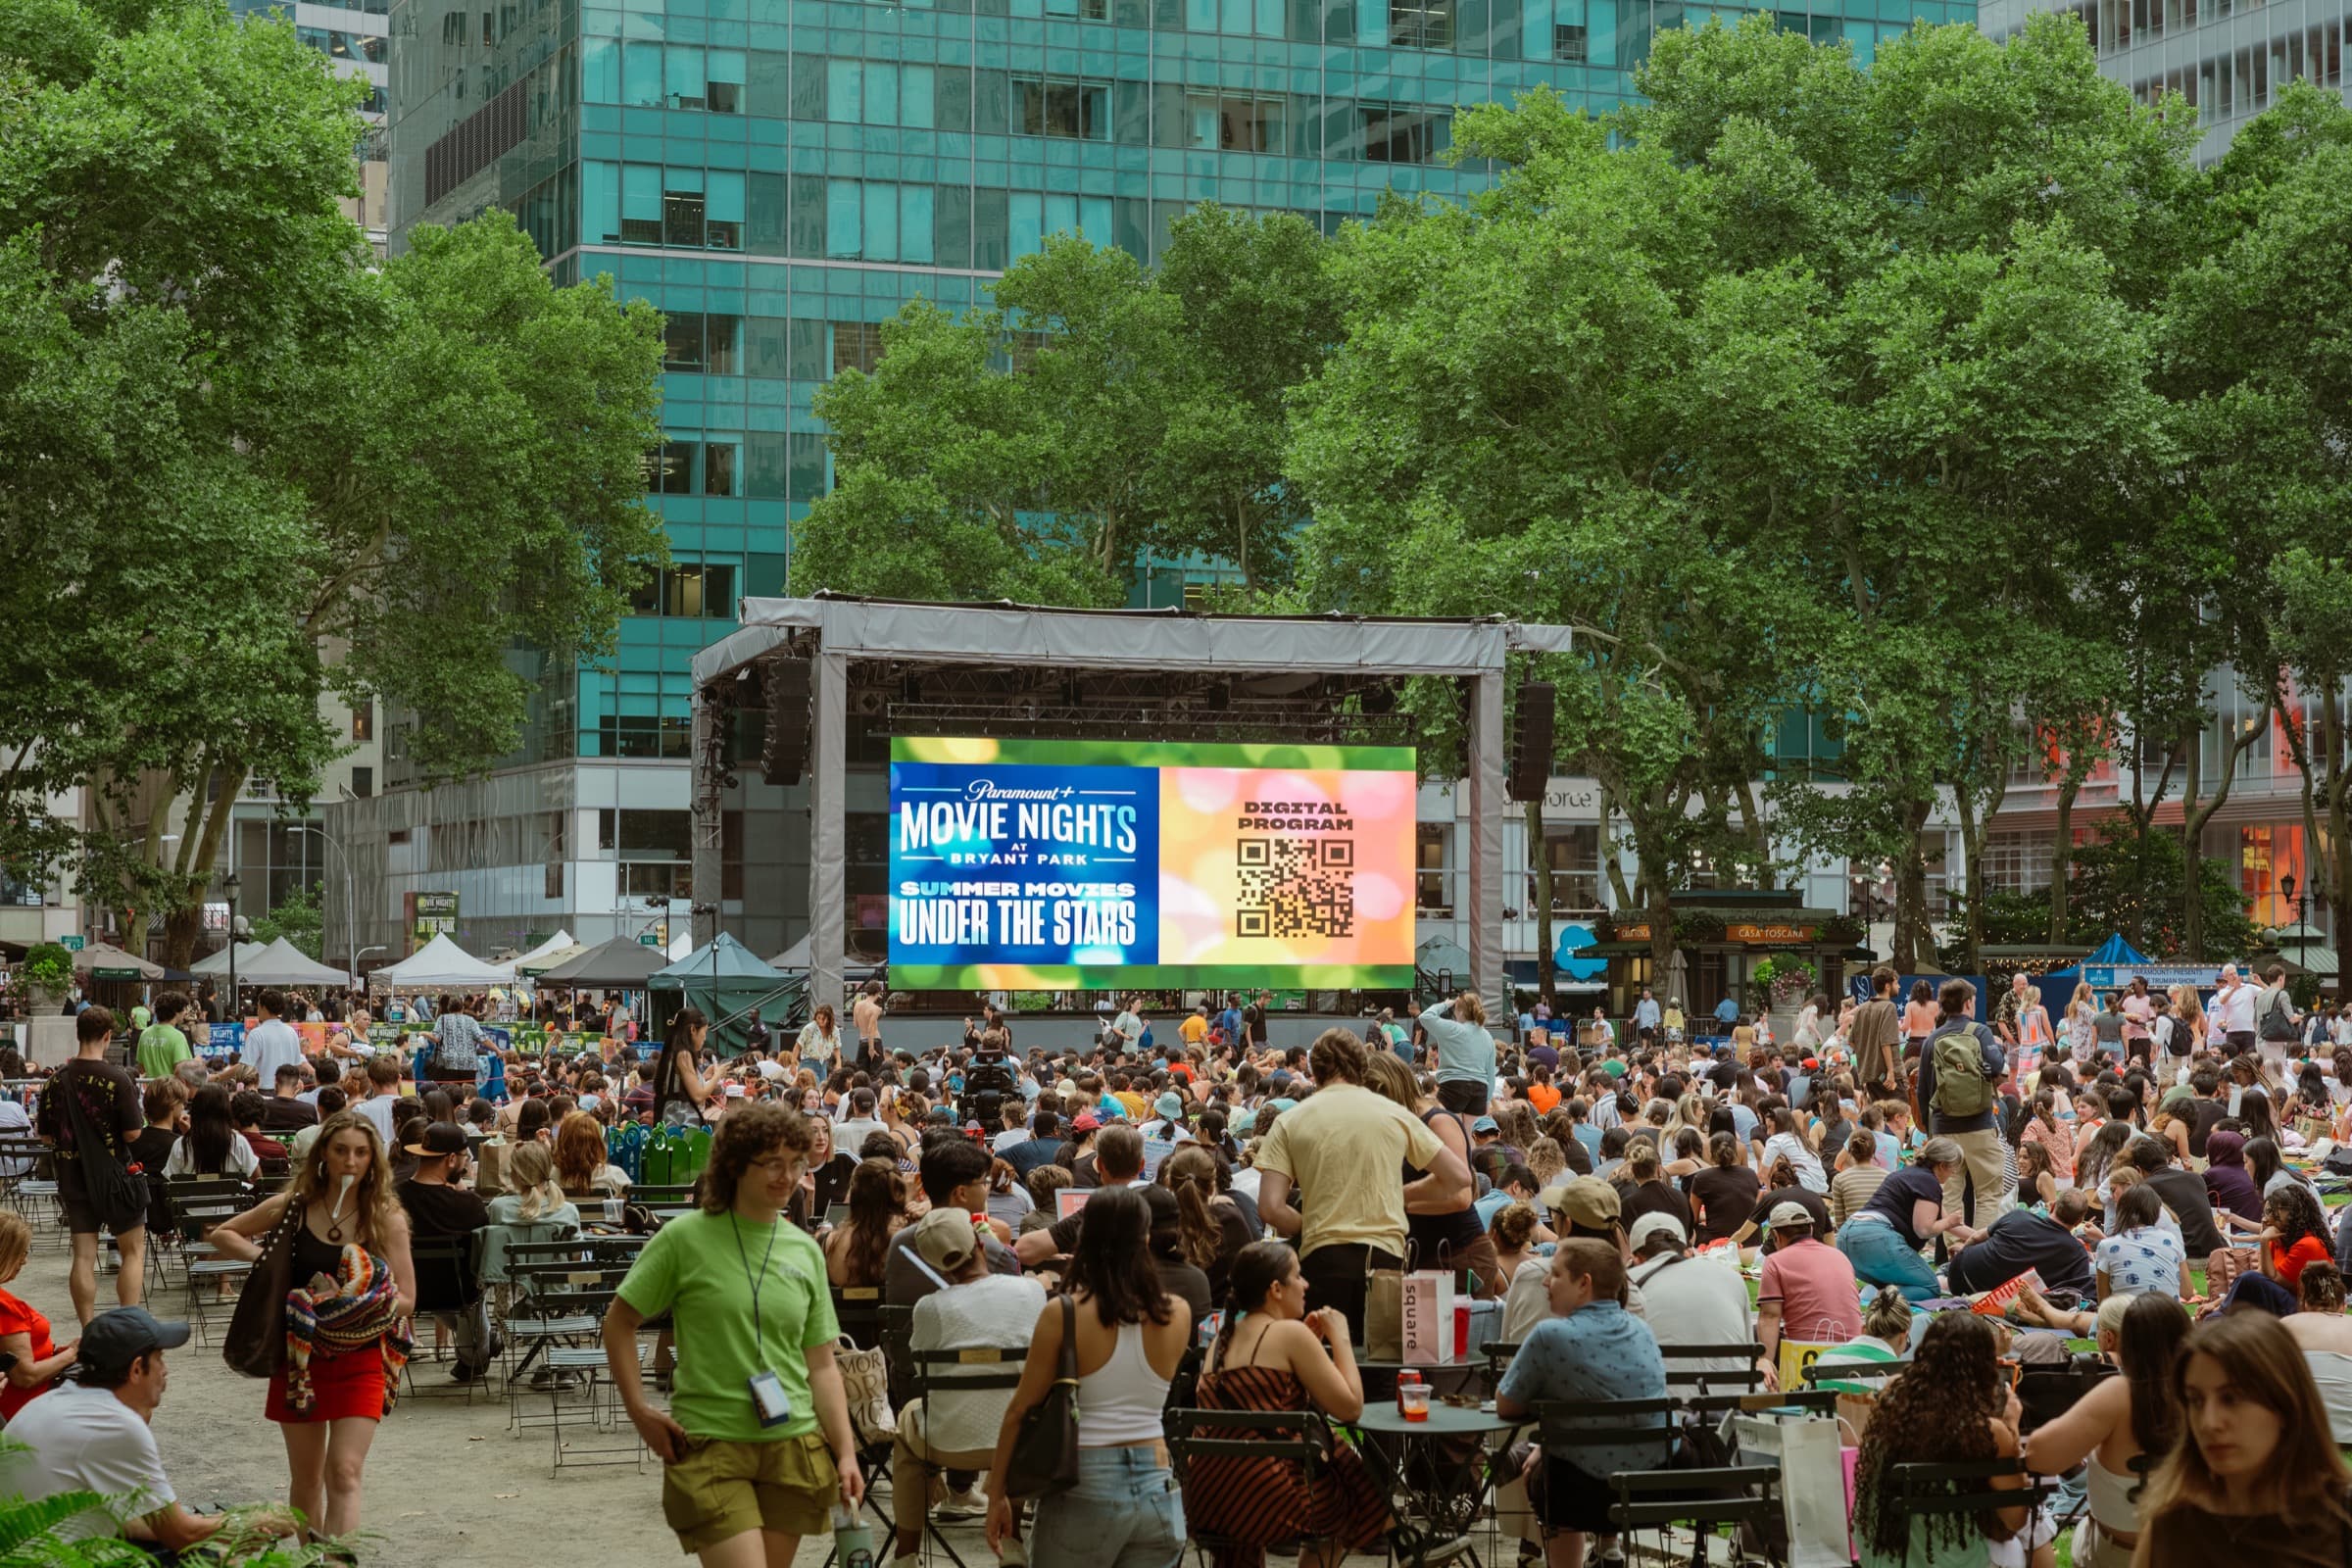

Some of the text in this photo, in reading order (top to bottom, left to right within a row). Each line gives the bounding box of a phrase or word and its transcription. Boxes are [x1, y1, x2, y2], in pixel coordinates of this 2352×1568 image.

[964, 779, 1075, 802] Paramount+
[1244, 801, 1348, 814] DIGITAL
[901, 802, 1137, 855] MOVIE NIGHTS
[1238, 817, 1353, 831] PROGRAM
[1011, 843, 1027, 852] AT
[950, 854, 1088, 866] BRYANT PARK
[900, 881, 1136, 897] SUMMER MOVIES
[418, 919, 455, 933] IN THE PARK
[899, 900, 1136, 946] UNDER THE STARS
[1739, 928, 1804, 939] CASA TOSCANA
[213, 1029, 234, 1041] NIGHTS
[1403, 1285, 1417, 1349] square
